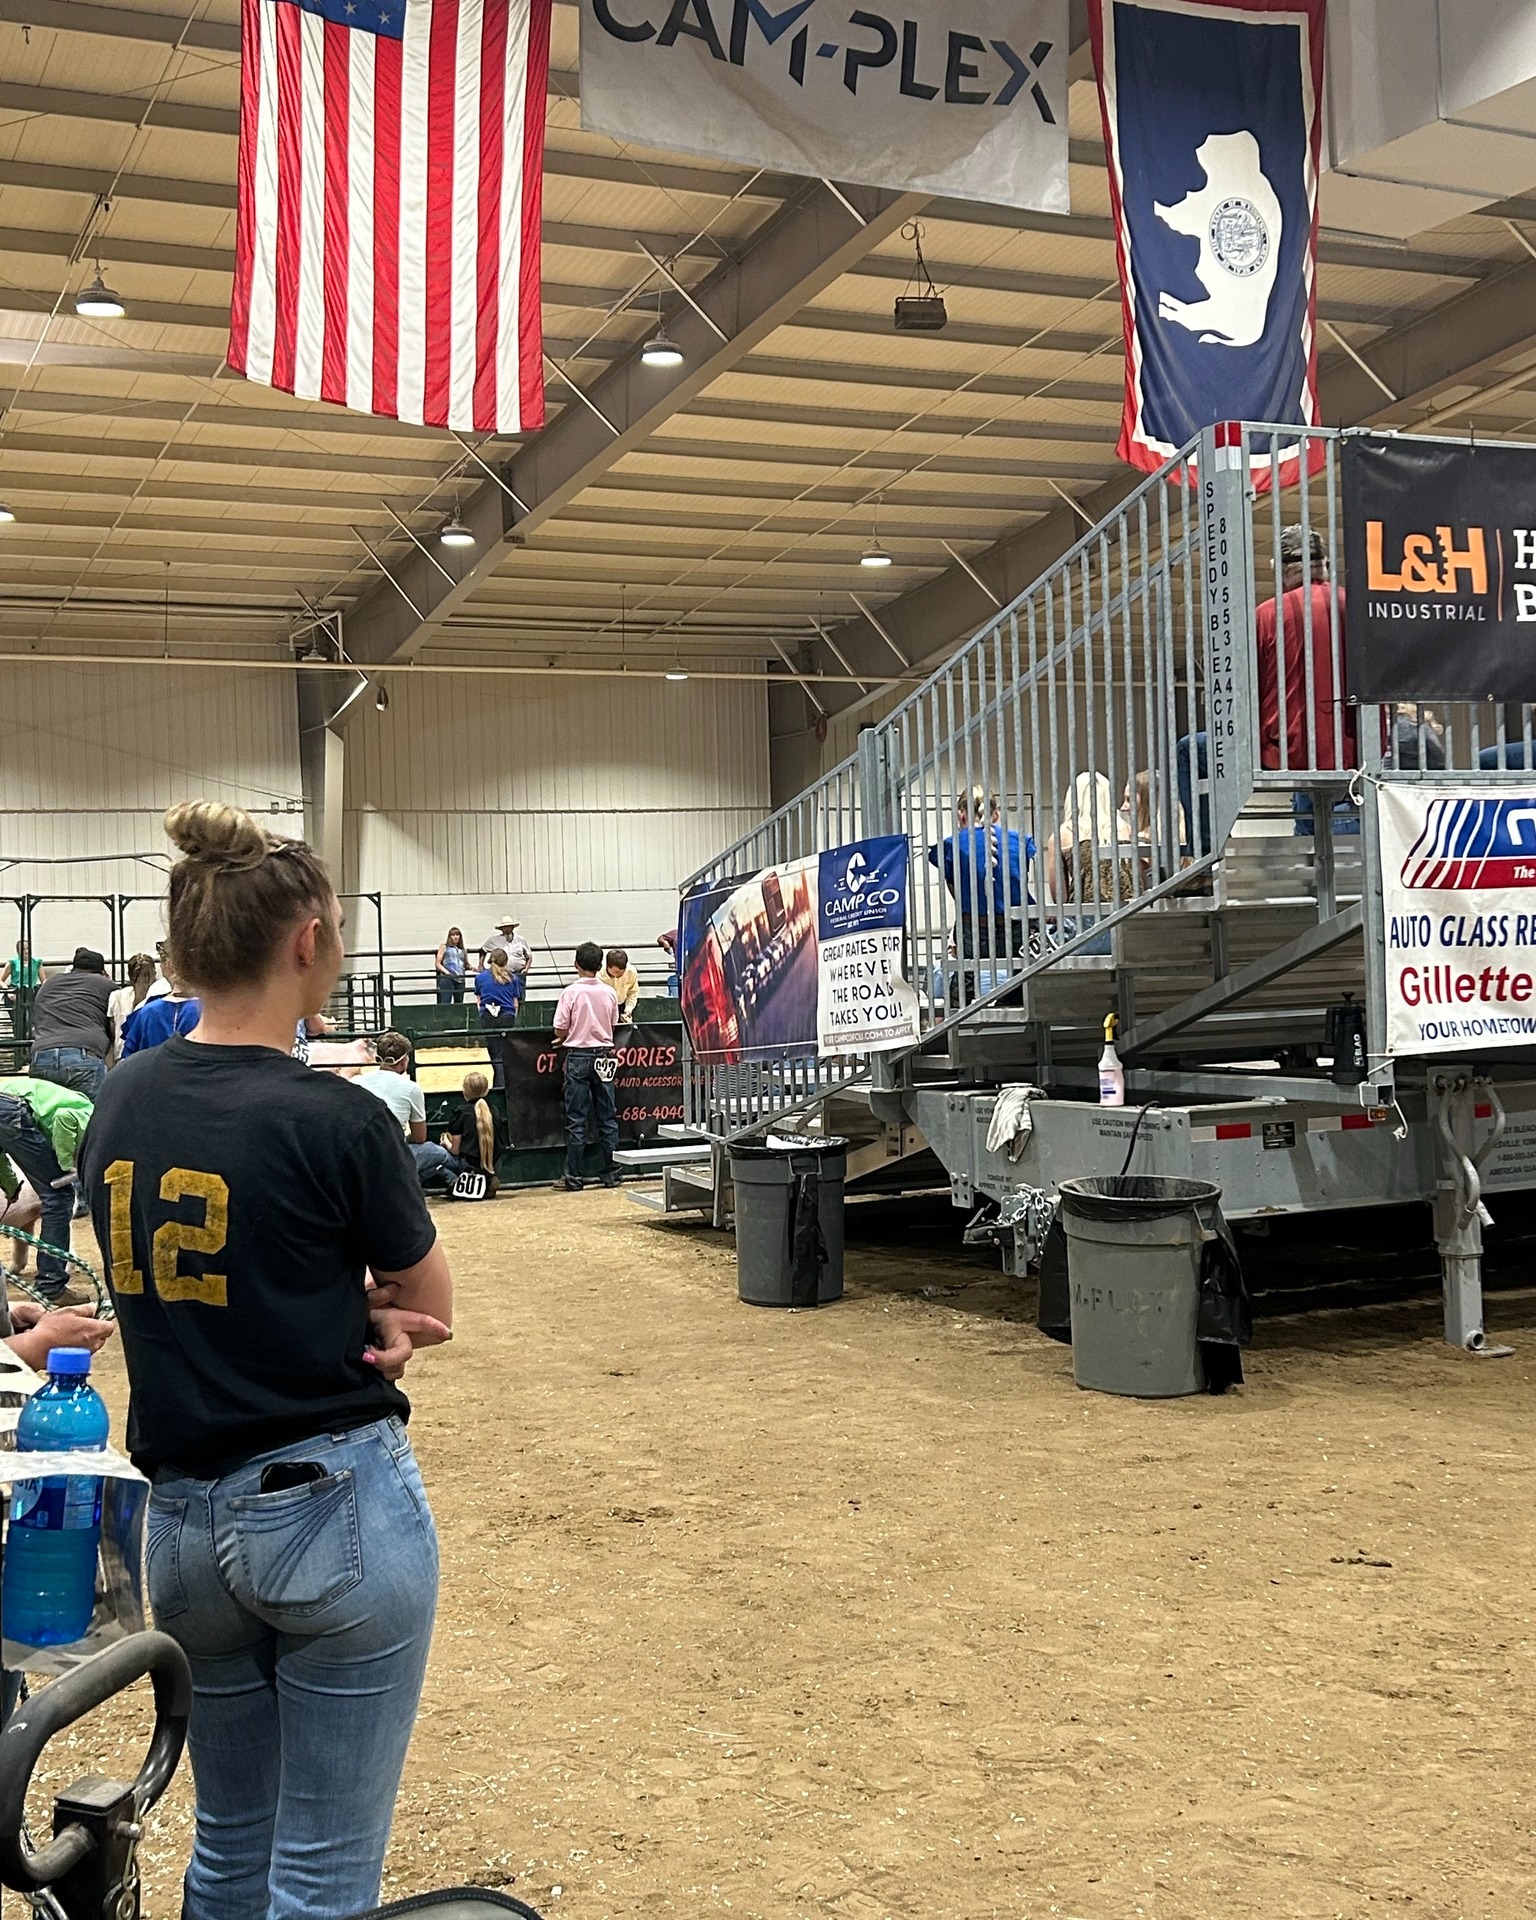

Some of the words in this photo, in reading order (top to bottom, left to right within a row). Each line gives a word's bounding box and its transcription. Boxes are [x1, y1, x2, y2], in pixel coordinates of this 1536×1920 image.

[593, 0, 1057, 125] CAM-PLEX
[1206, 481, 1218, 605] SPEEDY
[1365, 520, 1488, 594] L&H
[1368, 602, 1486, 621] INDUSTRIAL
[1210, 614, 1225, 779] BLEACHER
[1514, 865, 1536, 879] The
[825, 888, 900, 916] CAMPCO
[1390, 915, 1431, 948] AUTO
[1440, 915, 1509, 947] GLASS
[823, 944, 844, 962] GREAT
[846, 938, 878, 957] RATES
[882, 936, 900, 952] FOR
[833, 987, 848, 1004] THE
[1400, 965, 1533, 1006] Gillette
[830, 1009, 858, 1026] TAKES
[863, 1001, 903, 1022] YOU!
[884, 1029, 894, 1037] TO
[1419, 1021, 1461, 1040] YOUR
[536, 1053, 557, 1074] CT
[621, 1077, 640, 1088] AUTO
[643, 1076, 684, 1087] ACCESSOR
[456, 1174, 483, 1196] 601
[104, 1159, 230, 1307] 12
